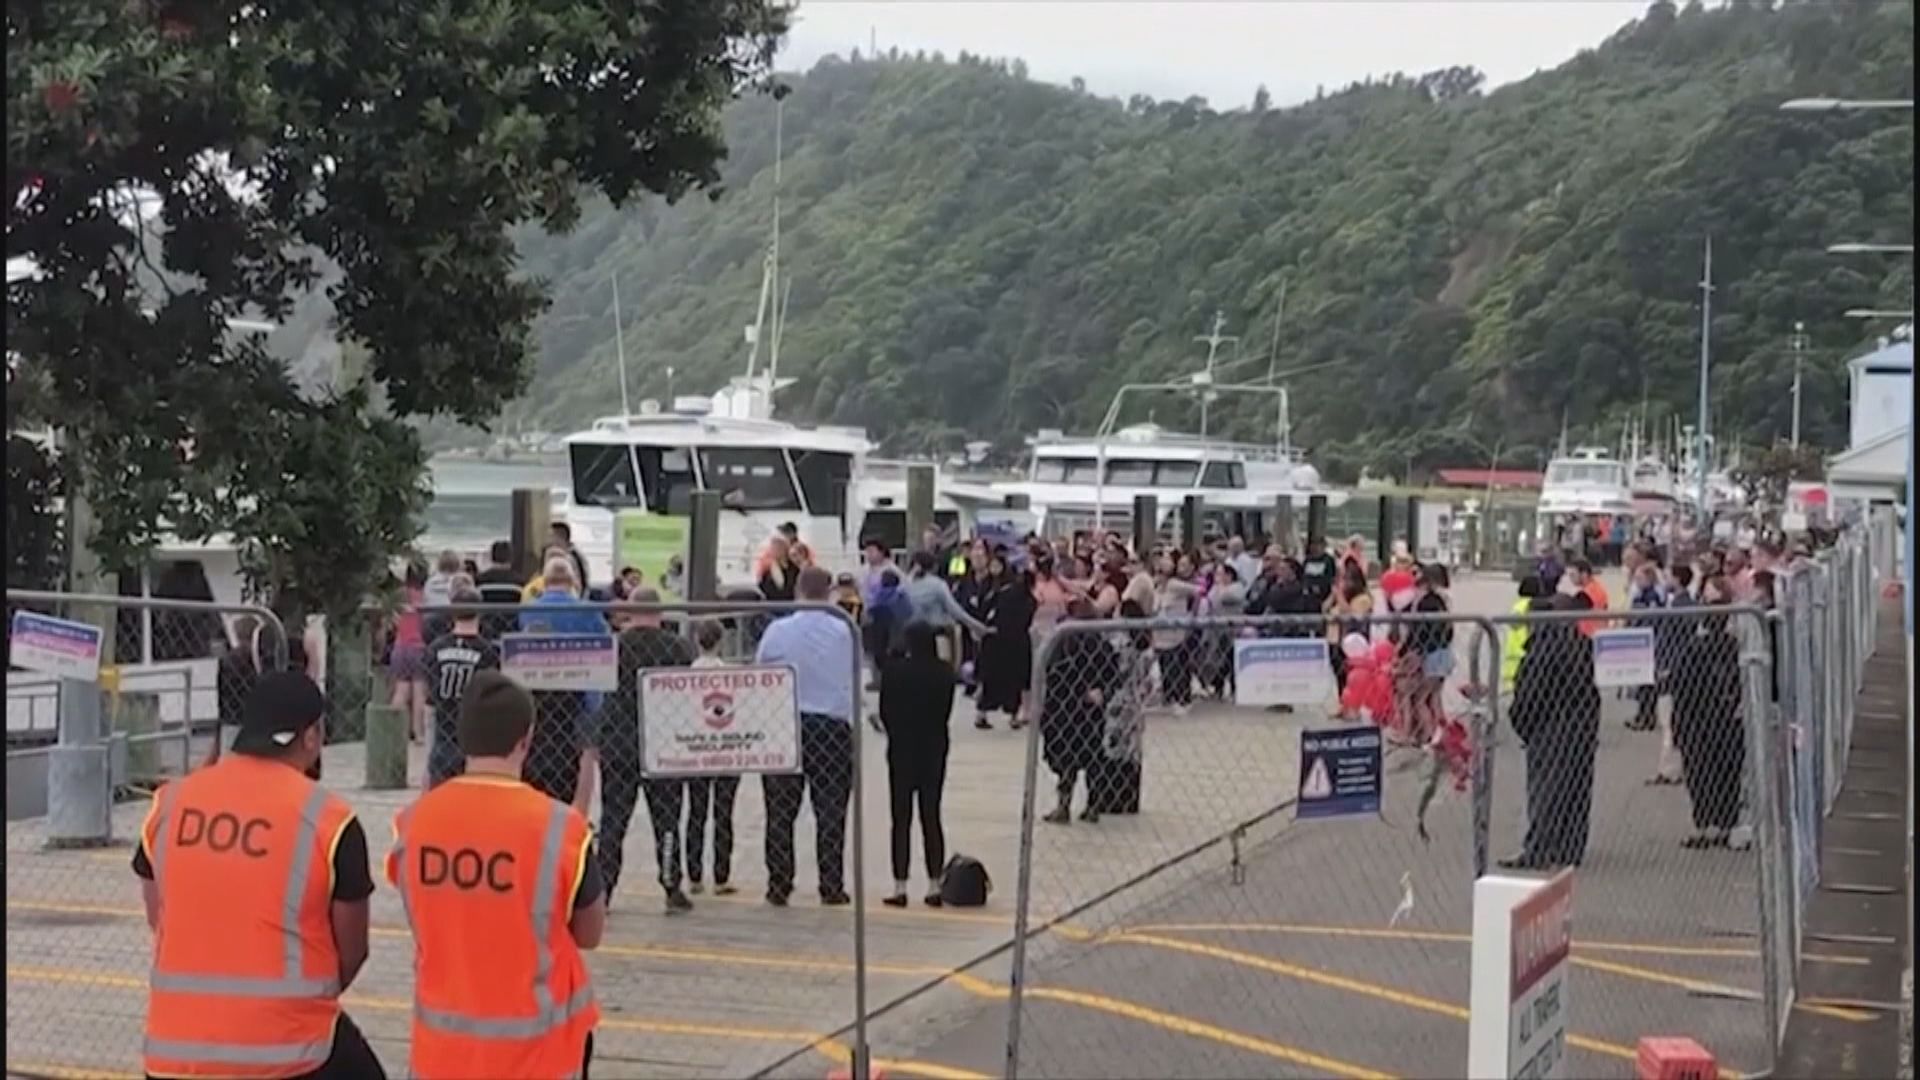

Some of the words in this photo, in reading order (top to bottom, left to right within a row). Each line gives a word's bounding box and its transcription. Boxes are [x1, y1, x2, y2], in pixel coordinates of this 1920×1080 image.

[650, 673, 756, 691] PROTECTED
[761, 672, 785, 687] BY
[687, 743, 752, 752] SECURITY
[1303, 739, 1320, 752] NO
[176, 807, 273, 858] DOC
[420, 846, 516, 892] DOC
